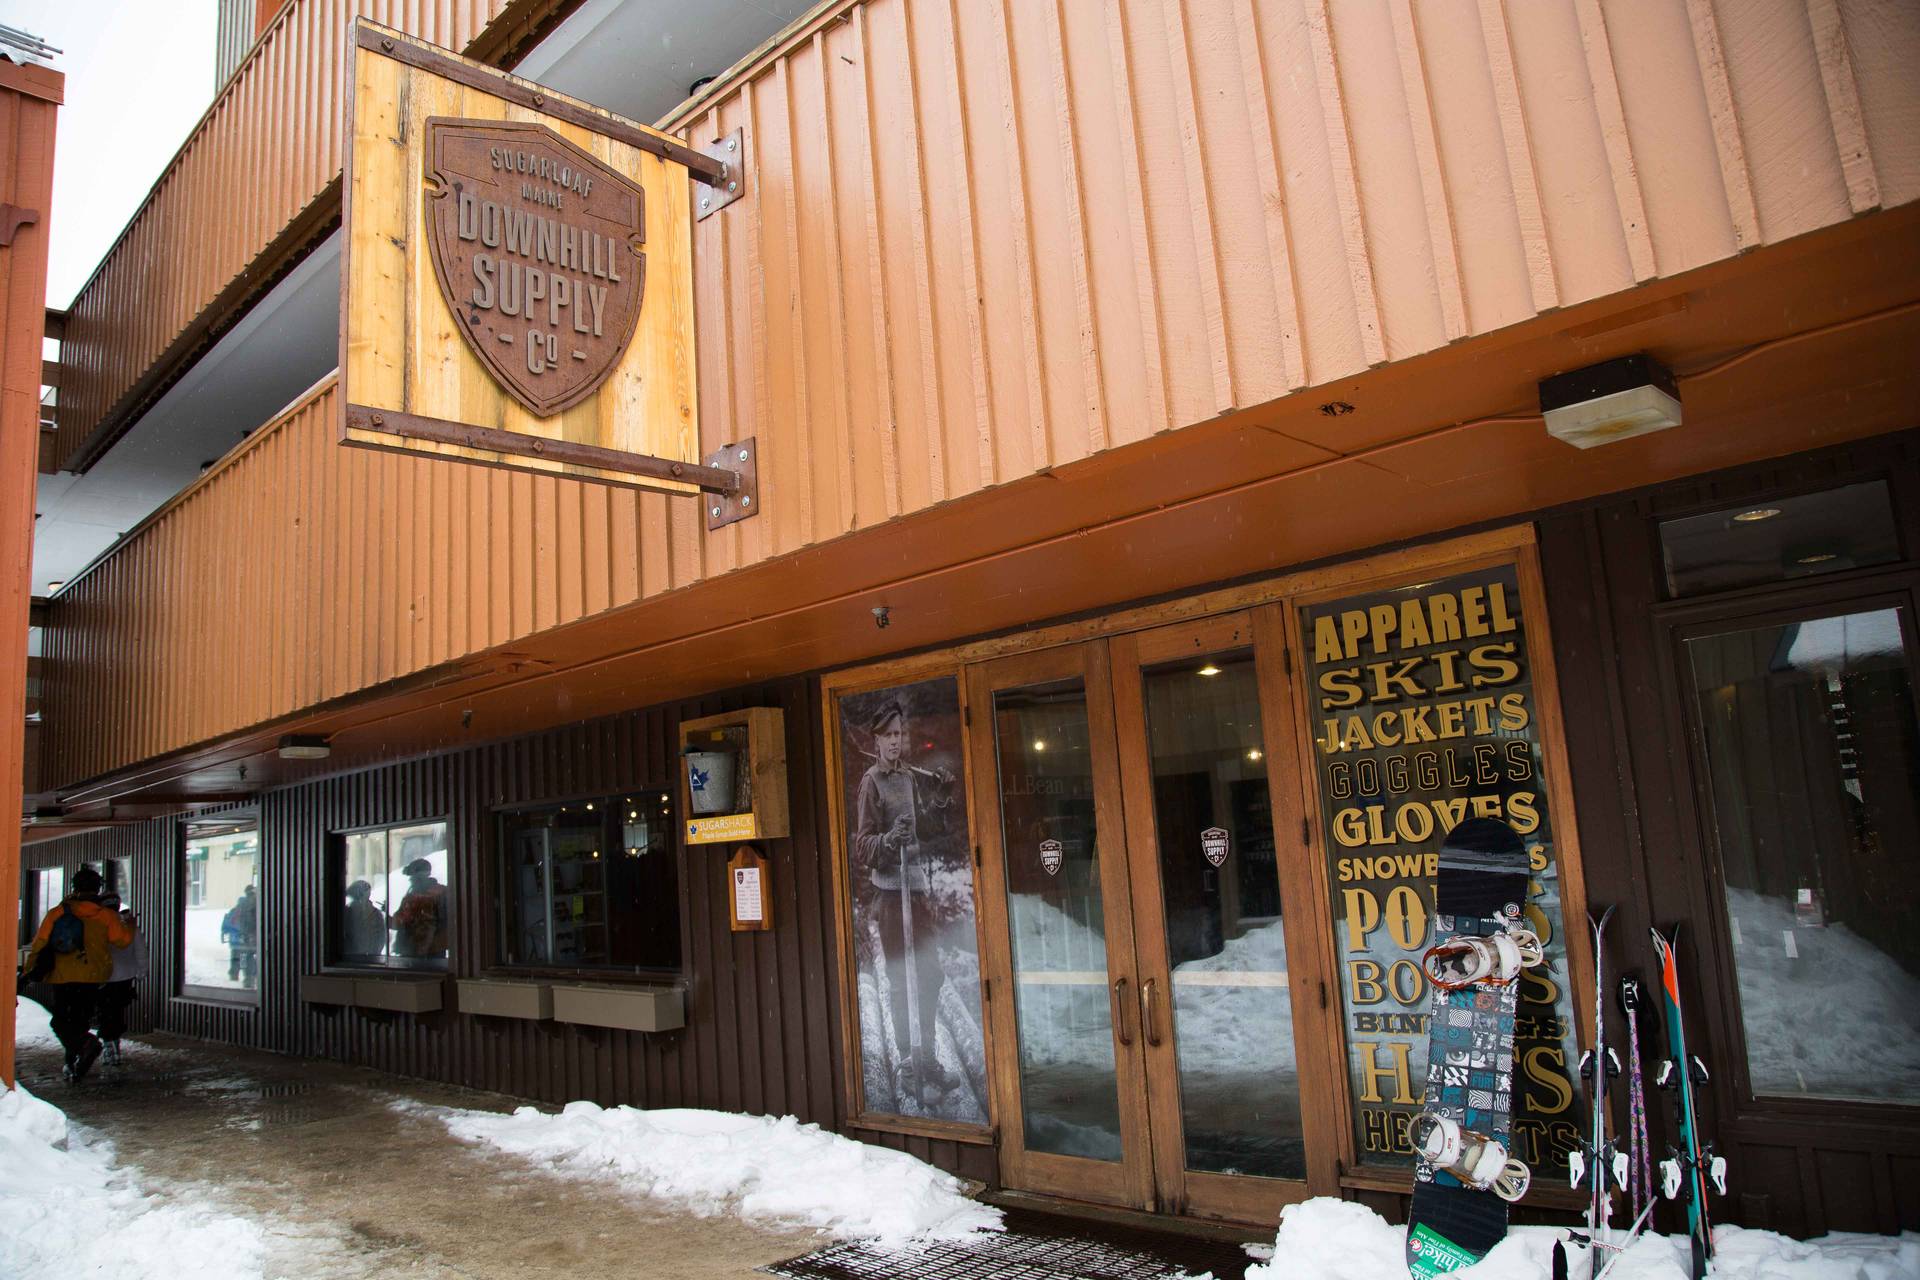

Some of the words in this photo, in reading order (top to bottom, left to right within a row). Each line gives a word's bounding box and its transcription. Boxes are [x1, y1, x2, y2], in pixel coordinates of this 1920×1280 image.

[491, 147, 593, 198] SUGARLOAF
[522, 182, 564, 211] MAINE
[458, 193, 621, 283] DOWNHILL
[473, 253, 608, 336] SUPPLY
[1316, 583, 1516, 663] APPAREL
[1319, 641, 1519, 709] SKIS
[1324, 694, 1529, 753] JACKETS
[1328, 740, 1532, 799] GOGGLES
[1333, 791, 1541, 847] GLOVES
[1337, 844, 1548, 882] SNOWBS
